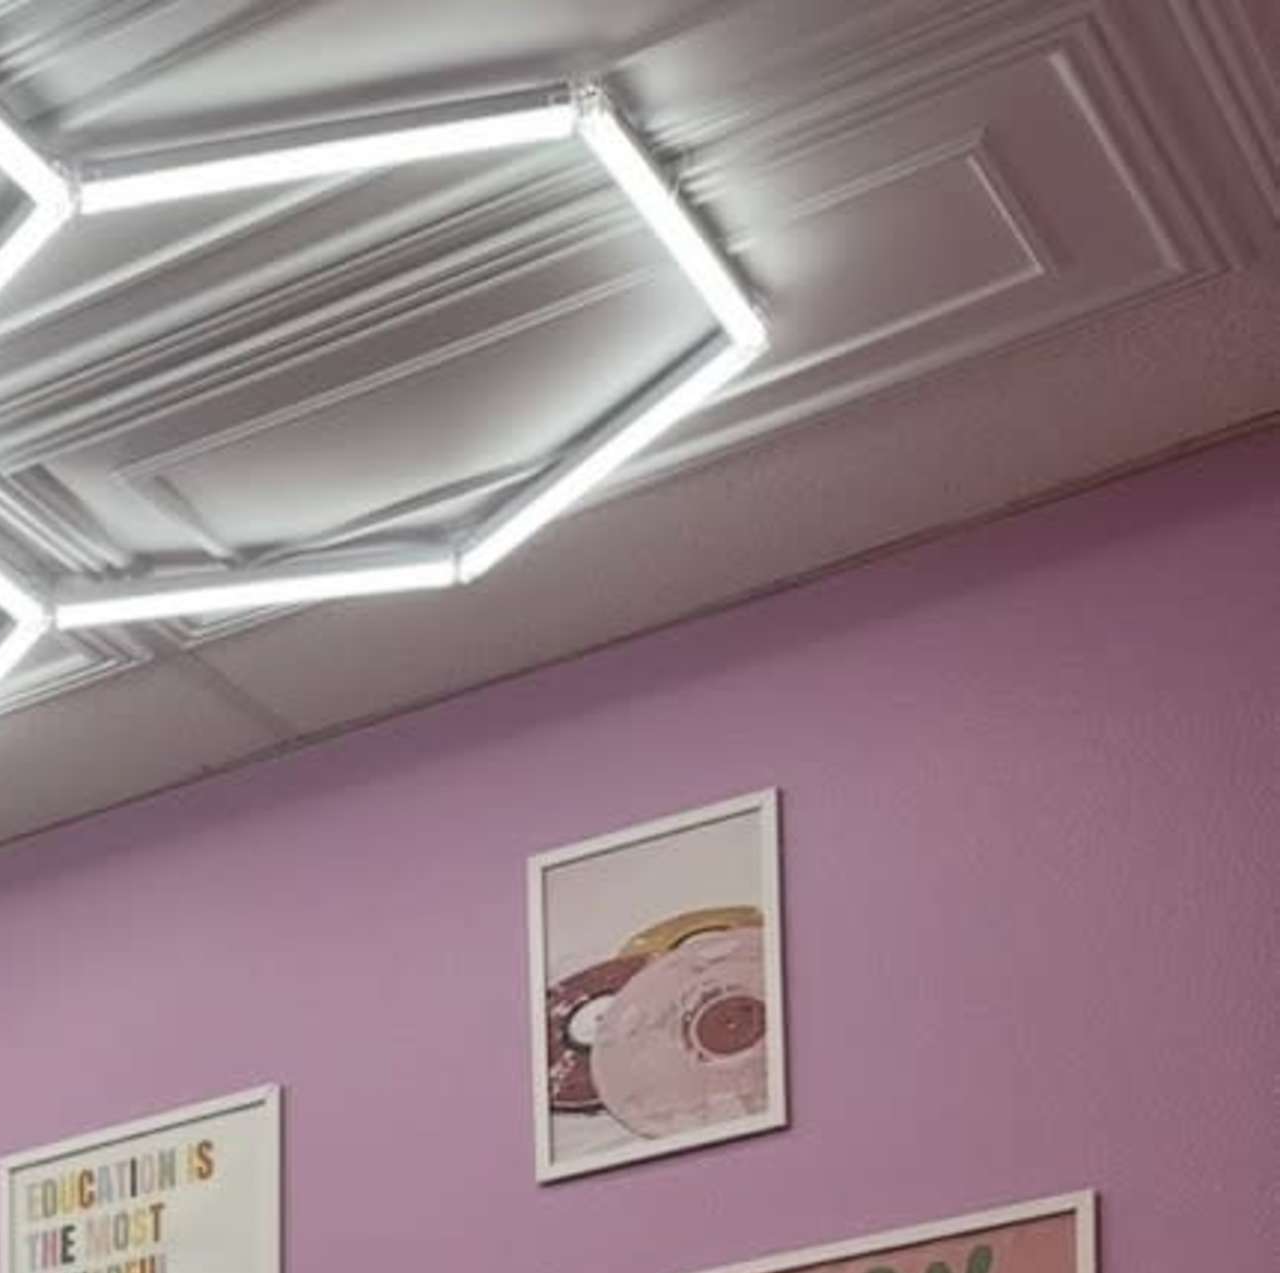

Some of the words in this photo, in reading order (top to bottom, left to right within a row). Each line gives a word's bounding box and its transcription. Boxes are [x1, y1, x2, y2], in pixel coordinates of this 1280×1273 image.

[26, 1148, 176, 1221] EDUCATION
[185, 1139, 214, 1183] IS
[26, 1224, 76, 1272] THE
[87, 1202, 165, 1257] MOST
